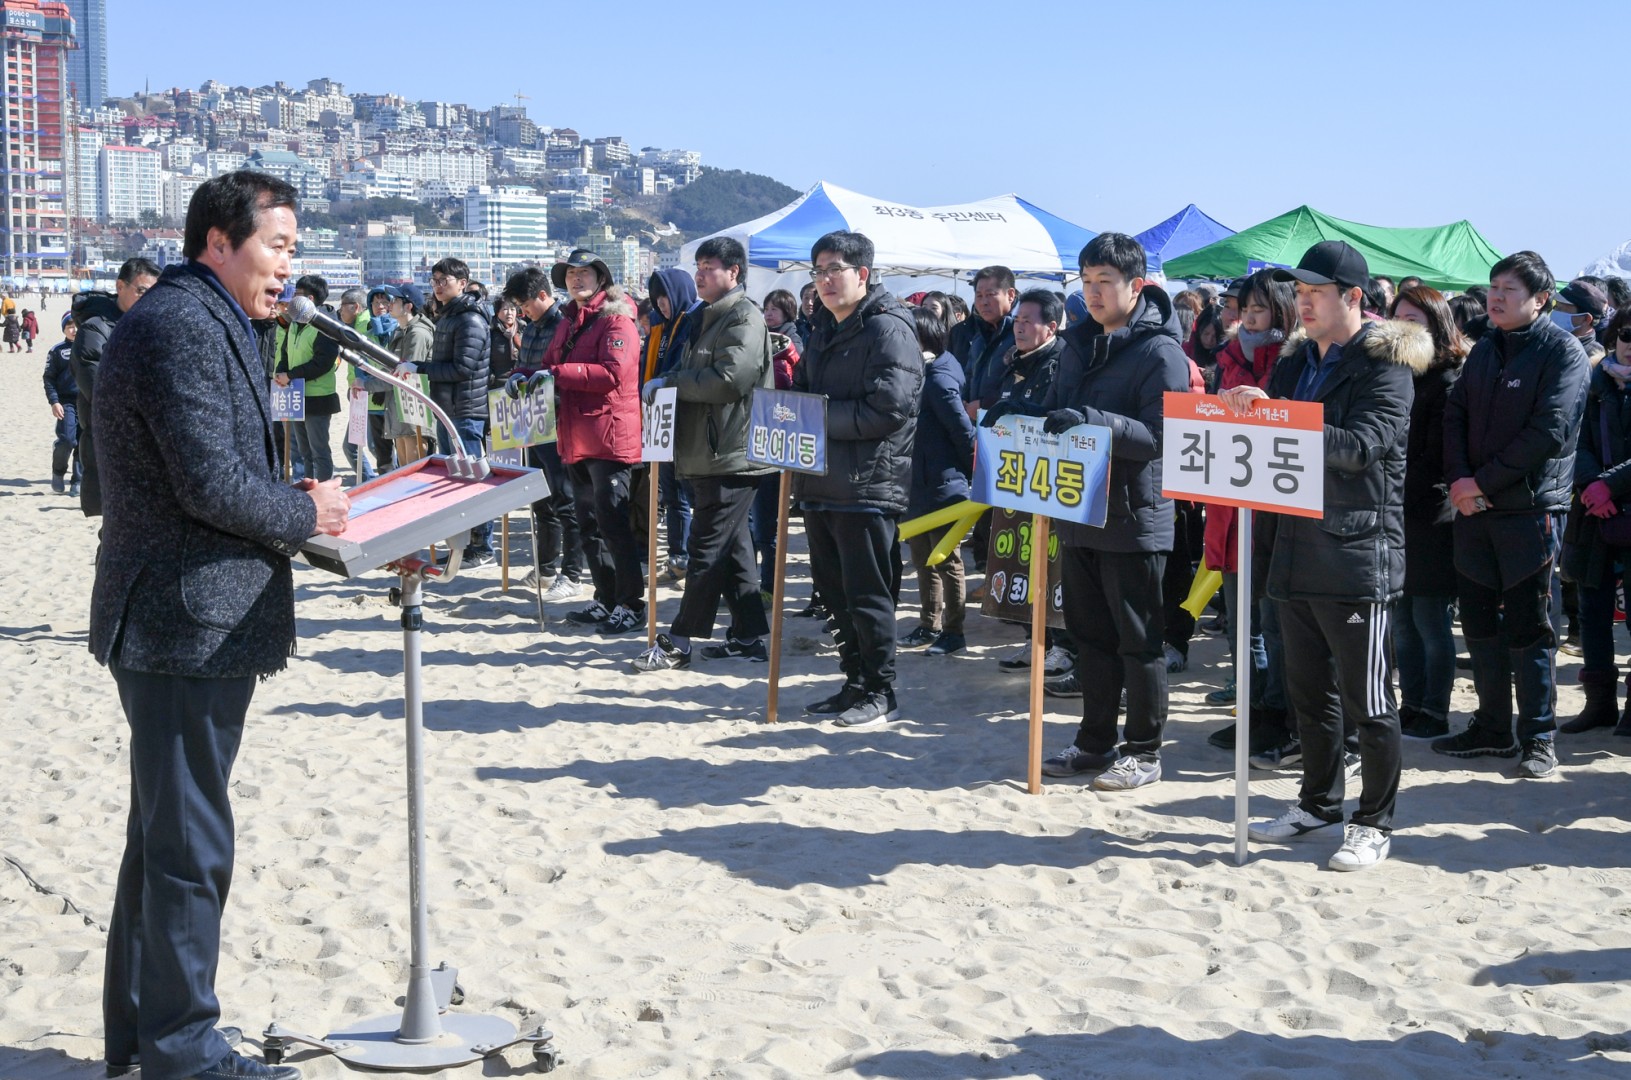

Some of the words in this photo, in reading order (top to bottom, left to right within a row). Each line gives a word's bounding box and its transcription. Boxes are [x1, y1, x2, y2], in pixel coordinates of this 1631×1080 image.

[872, 205, 924, 219] 좌3동
[930, 211, 1007, 223] 주민센터
[272, 390, 302, 412] 재송1동
[495, 388, 548, 441] 반여3동
[1262, 407, 1289, 423] 해운대
[641, 402, 673, 449] 여2동
[753, 426, 817, 468] 반여1동
[1071, 435, 1096, 451] 해운대
[997, 450, 1084, 507] 좌4동
